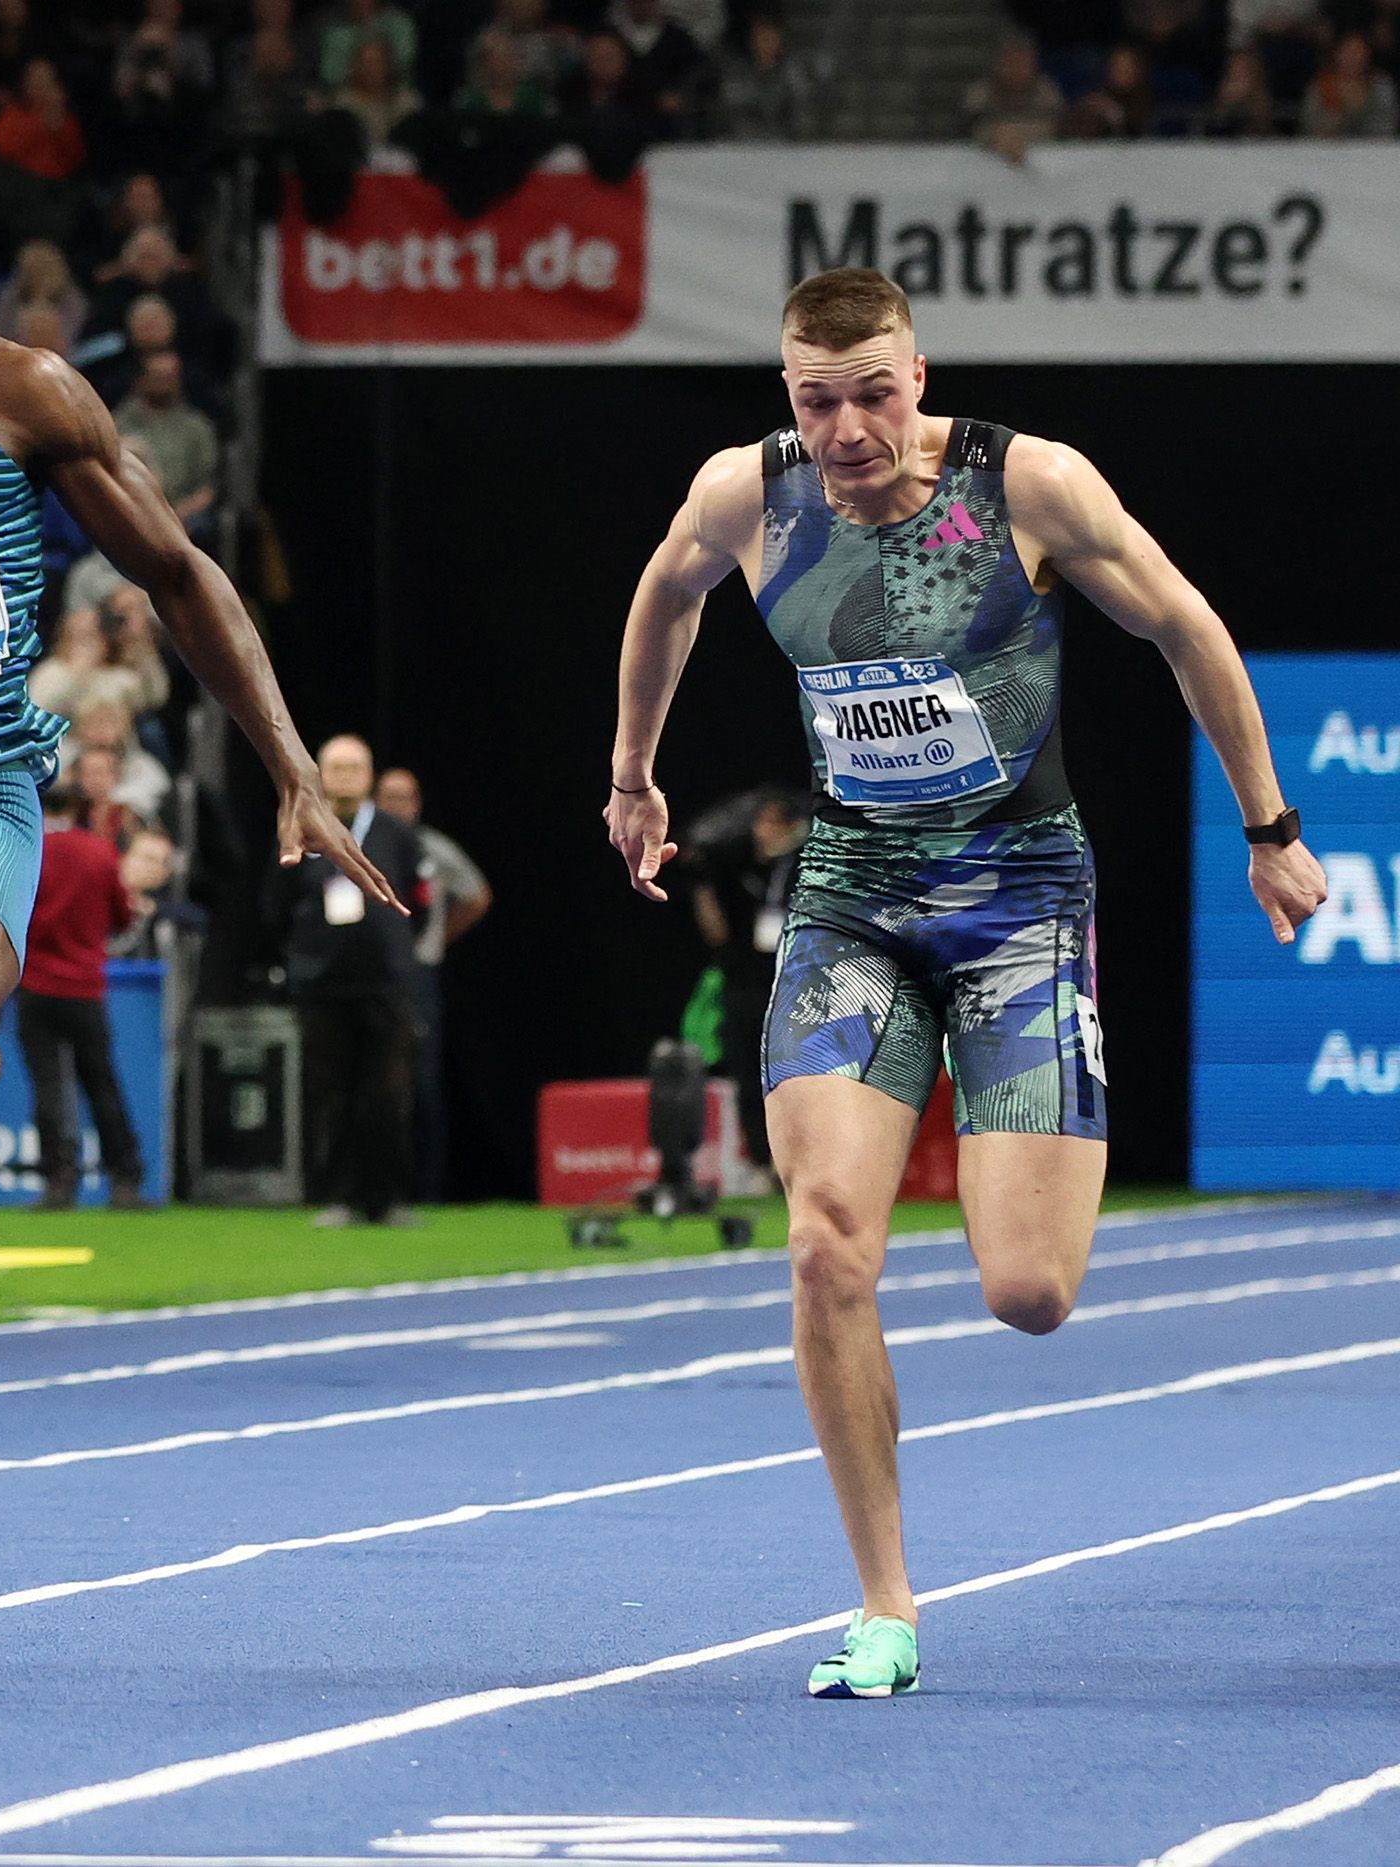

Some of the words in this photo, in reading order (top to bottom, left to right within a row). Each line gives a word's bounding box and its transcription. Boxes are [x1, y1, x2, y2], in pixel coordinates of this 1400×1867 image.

[303, 226, 619, 291] bett1.de
[787, 192, 1326, 299] Matratze?
[805, 670, 852, 691] BERLIN
[828, 694, 953, 742] WAGNER
[850, 751, 923, 770] Allianz
